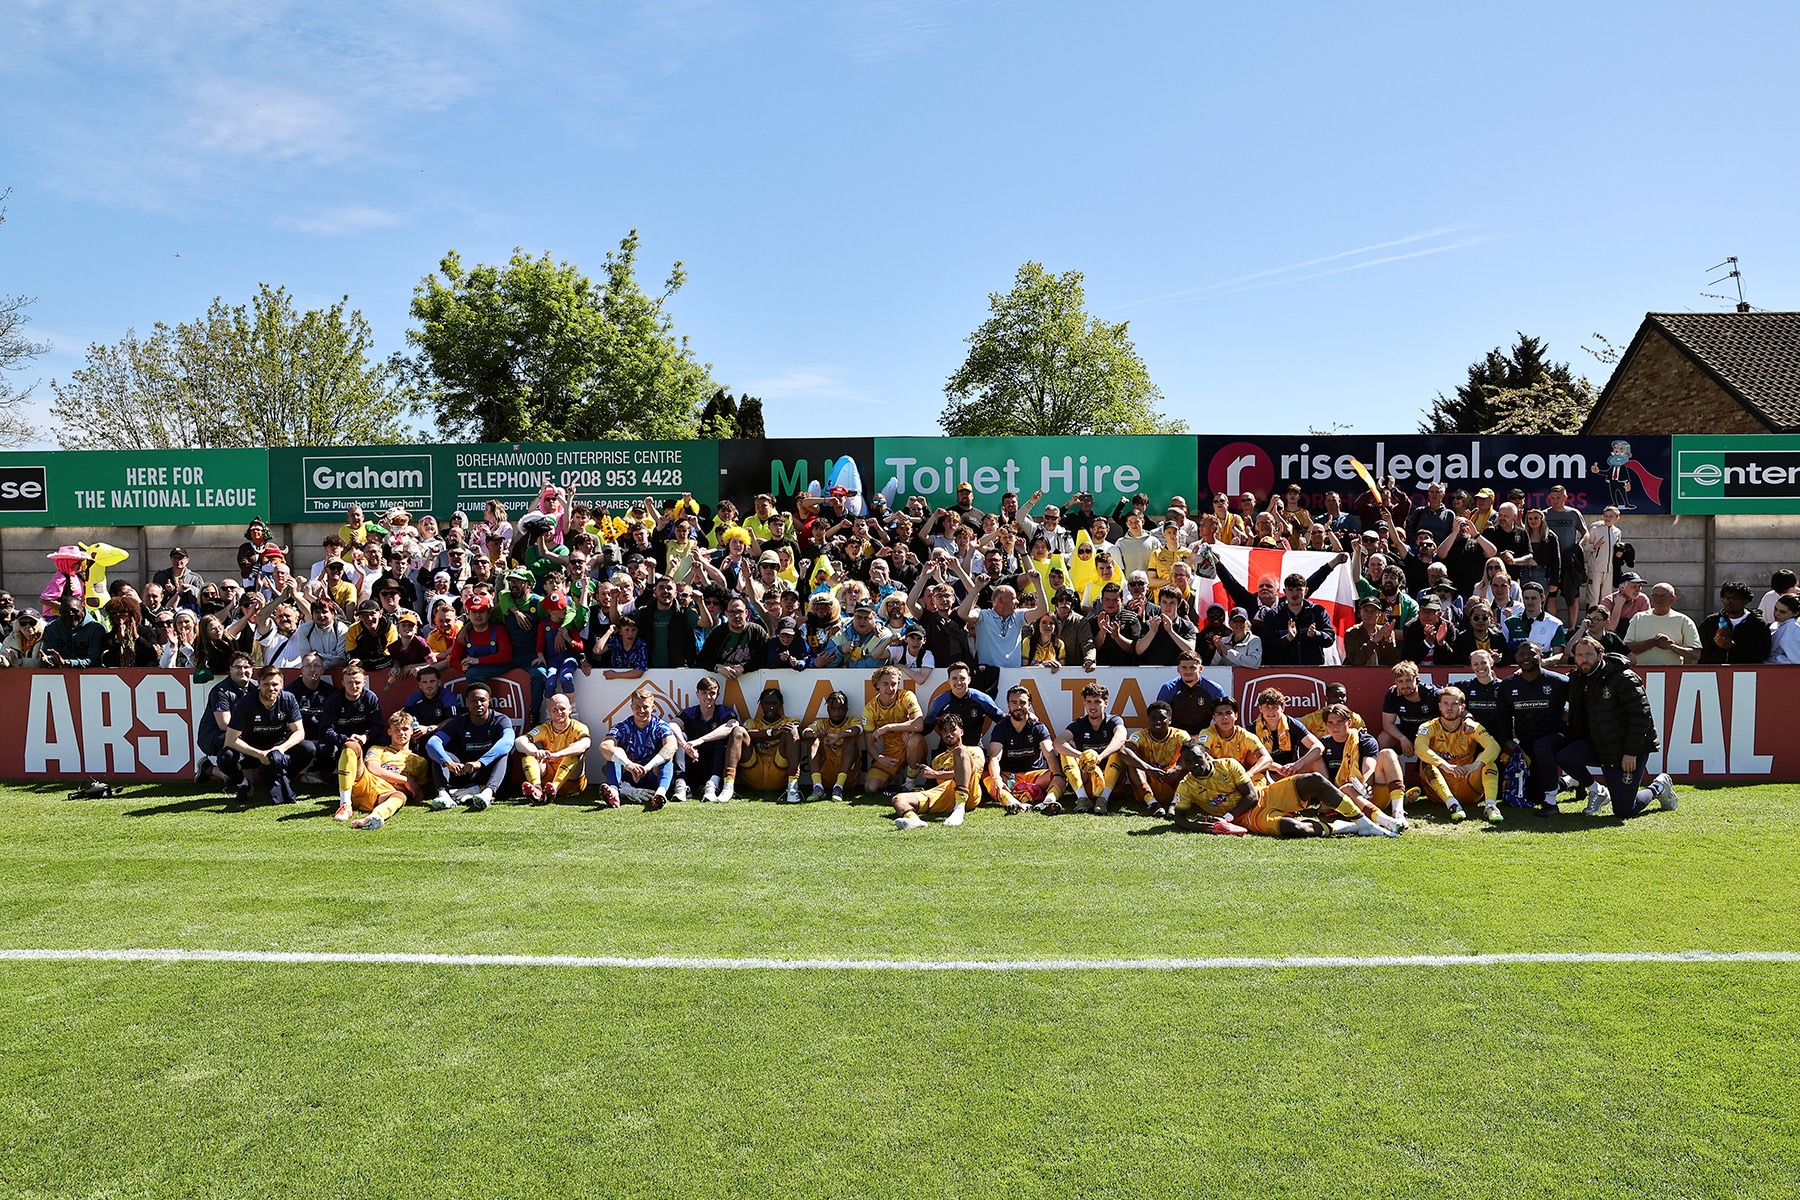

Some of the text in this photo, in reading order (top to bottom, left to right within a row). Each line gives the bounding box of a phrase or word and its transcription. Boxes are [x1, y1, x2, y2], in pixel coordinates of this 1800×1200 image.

[456, 450, 682, 467] BOREHAMWOOD ENTERPRISE CENTRE
[1281, 441, 1587, 490] rise-legal.com
[126, 466, 204, 486] HERE FOR
[312, 465, 424, 490] Graham
[560, 470, 602, 488] 0208
[605, 470, 637, 487] 953
[641, 469, 683, 487] 4428
[884, 456, 1021, 495] Toilet
[1040, 455, 1141, 494] Hire
[74, 488, 257, 509] THE NATIONAL LEAGUE
[313, 500, 331, 510] The
[380, 499, 424, 509] Merchant
[595, 500, 630, 510] SPARES
